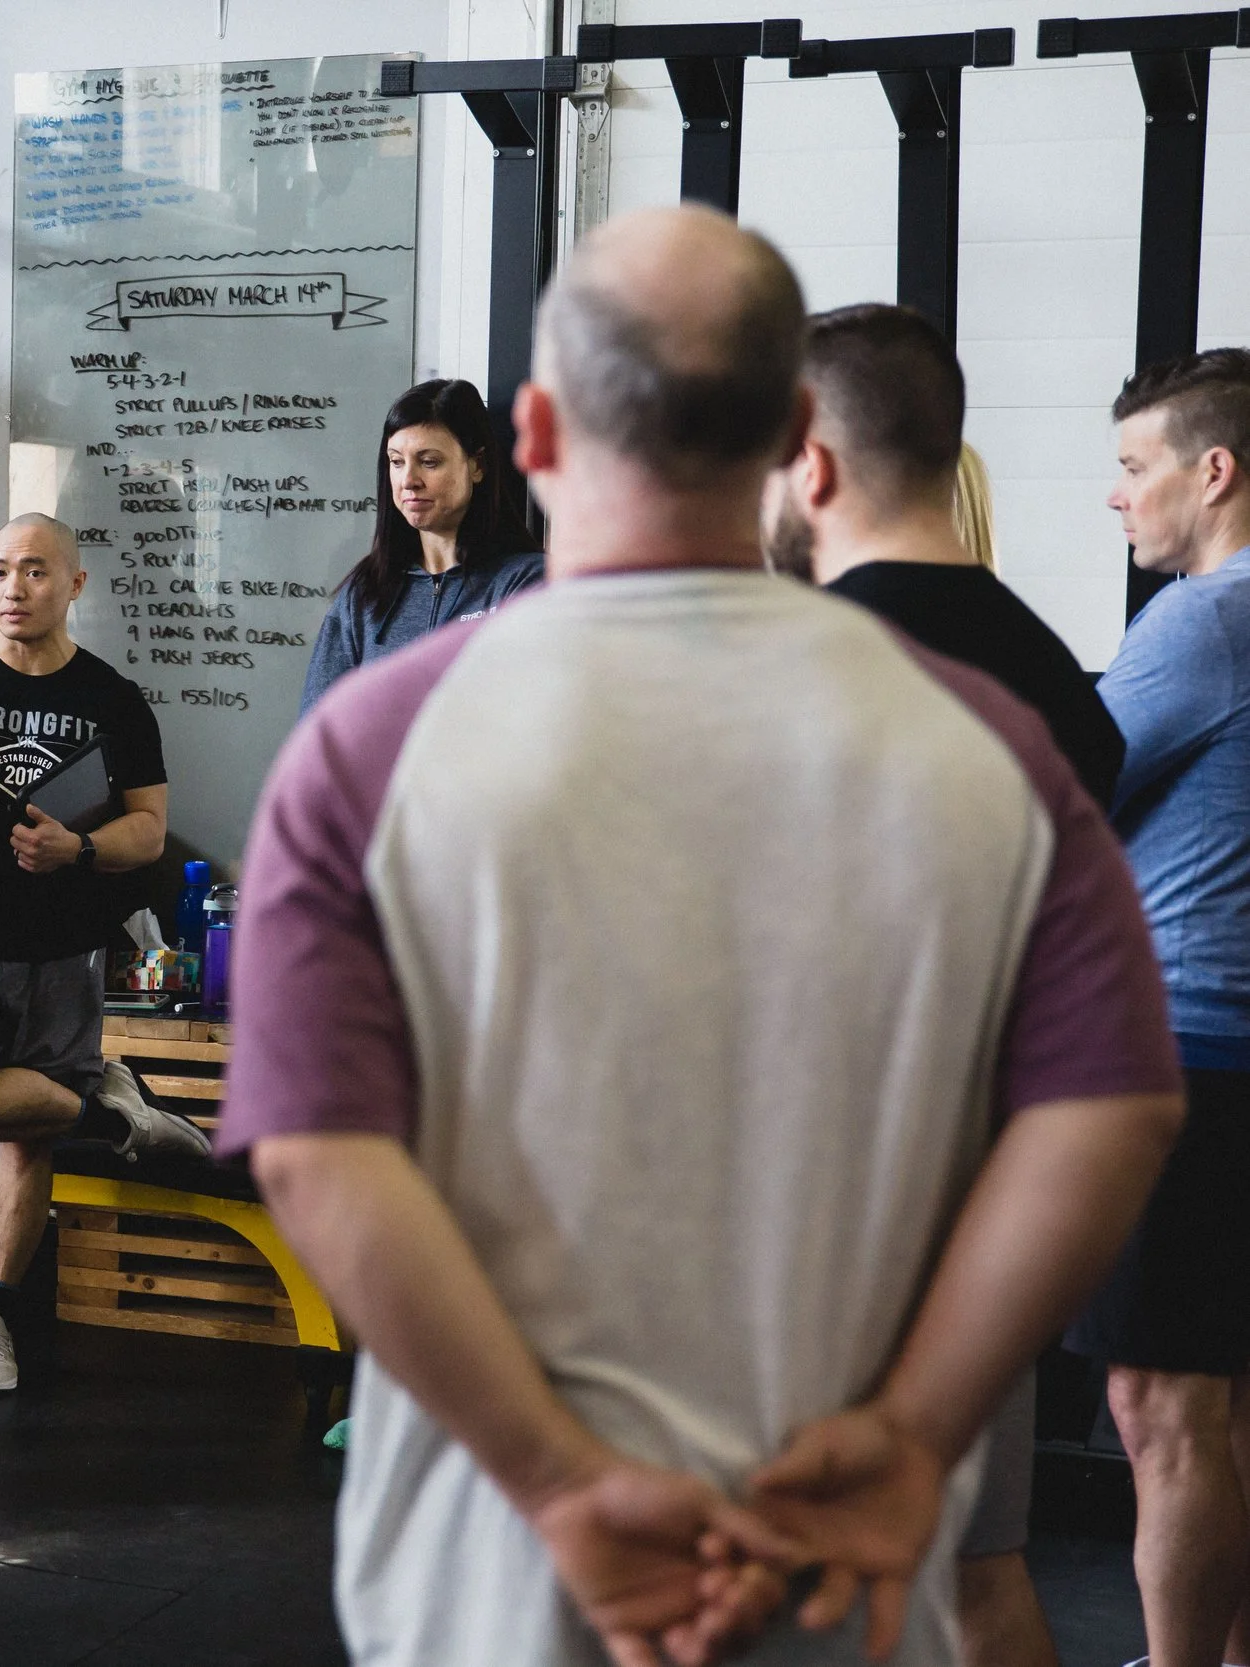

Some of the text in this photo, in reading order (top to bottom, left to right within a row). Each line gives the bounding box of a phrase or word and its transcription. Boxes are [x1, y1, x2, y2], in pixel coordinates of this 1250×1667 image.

[127, 287, 219, 309] SATURDAY
[229, 284, 288, 306] MARCH
[71, 353, 119, 369] WARM
[107, 370, 187, 390] 5-4-3-2-1
[115, 398, 166, 415] STRICT
[115, 424, 166, 439] STRICT
[267, 416, 327, 431] RAISES
[118, 479, 171, 496] STRICT
[275, 475, 310, 492] UPS
[120, 499, 183, 514] REVERSE
[75, 527, 120, 542] ORK:
[121, 551, 137, 568] 5
[110, 573, 159, 599] 15/12
[121, 601, 236, 619] 12 DEADLIFTS
[127, 624, 307, 647] 9 HANG PWR CLEANS
[127, 647, 255, 669] 6 PUSH JERKS
[181, 687, 250, 711] 155/105
